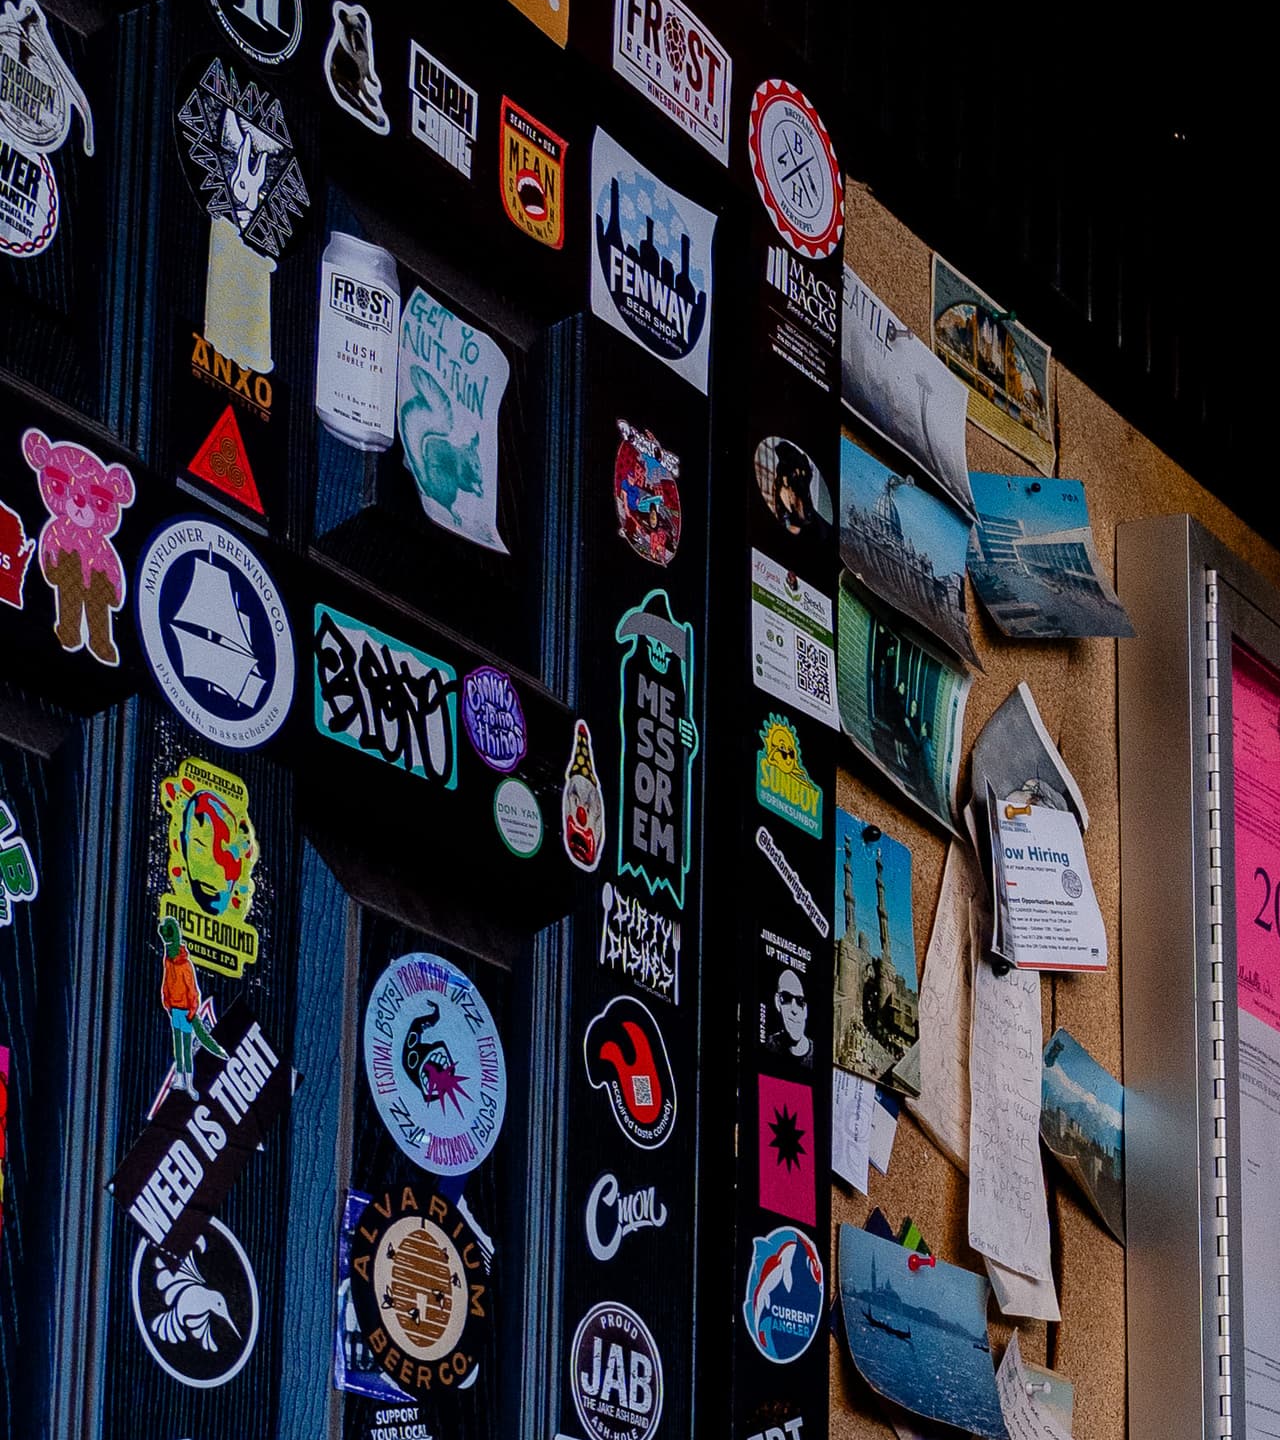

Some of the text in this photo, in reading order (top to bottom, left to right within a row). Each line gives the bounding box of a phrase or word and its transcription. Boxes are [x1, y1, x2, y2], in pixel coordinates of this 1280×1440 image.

[625, 38, 720, 130] BEER WORKS
[510, 137, 554, 203] MEAN
[610, 244, 693, 344] FENWAY
[411, 293, 480, 365] GET YO
[626, 296, 651, 322] BEER
[653, 316, 678, 339] SHOP
[345, 340, 376, 361] LUSH
[145, 527, 204, 595] MAYFLOWER
[217, 534, 272, 602] BREWING
[186, 762, 244, 796] FIDDLEHEAD
[1028, 846, 1070, 867] Hiring
[129, 1021, 280, 1245] WEED IS TIGHT
[653, 1100, 673, 1139] comedy
[354, 1185, 486, 1318] ALVARIUM
[600, 1314, 639, 1341] PROUD
[770, 1303, 815, 1325] CURRENT
[771, 1317, 810, 1339] ANGLER
[367, 1328, 434, 1391] BEER
[581, 1336, 653, 1414] JAB
[376, 1408, 419, 1425] SUPPORT
[400, 1424, 428, 1440] LOCAL
